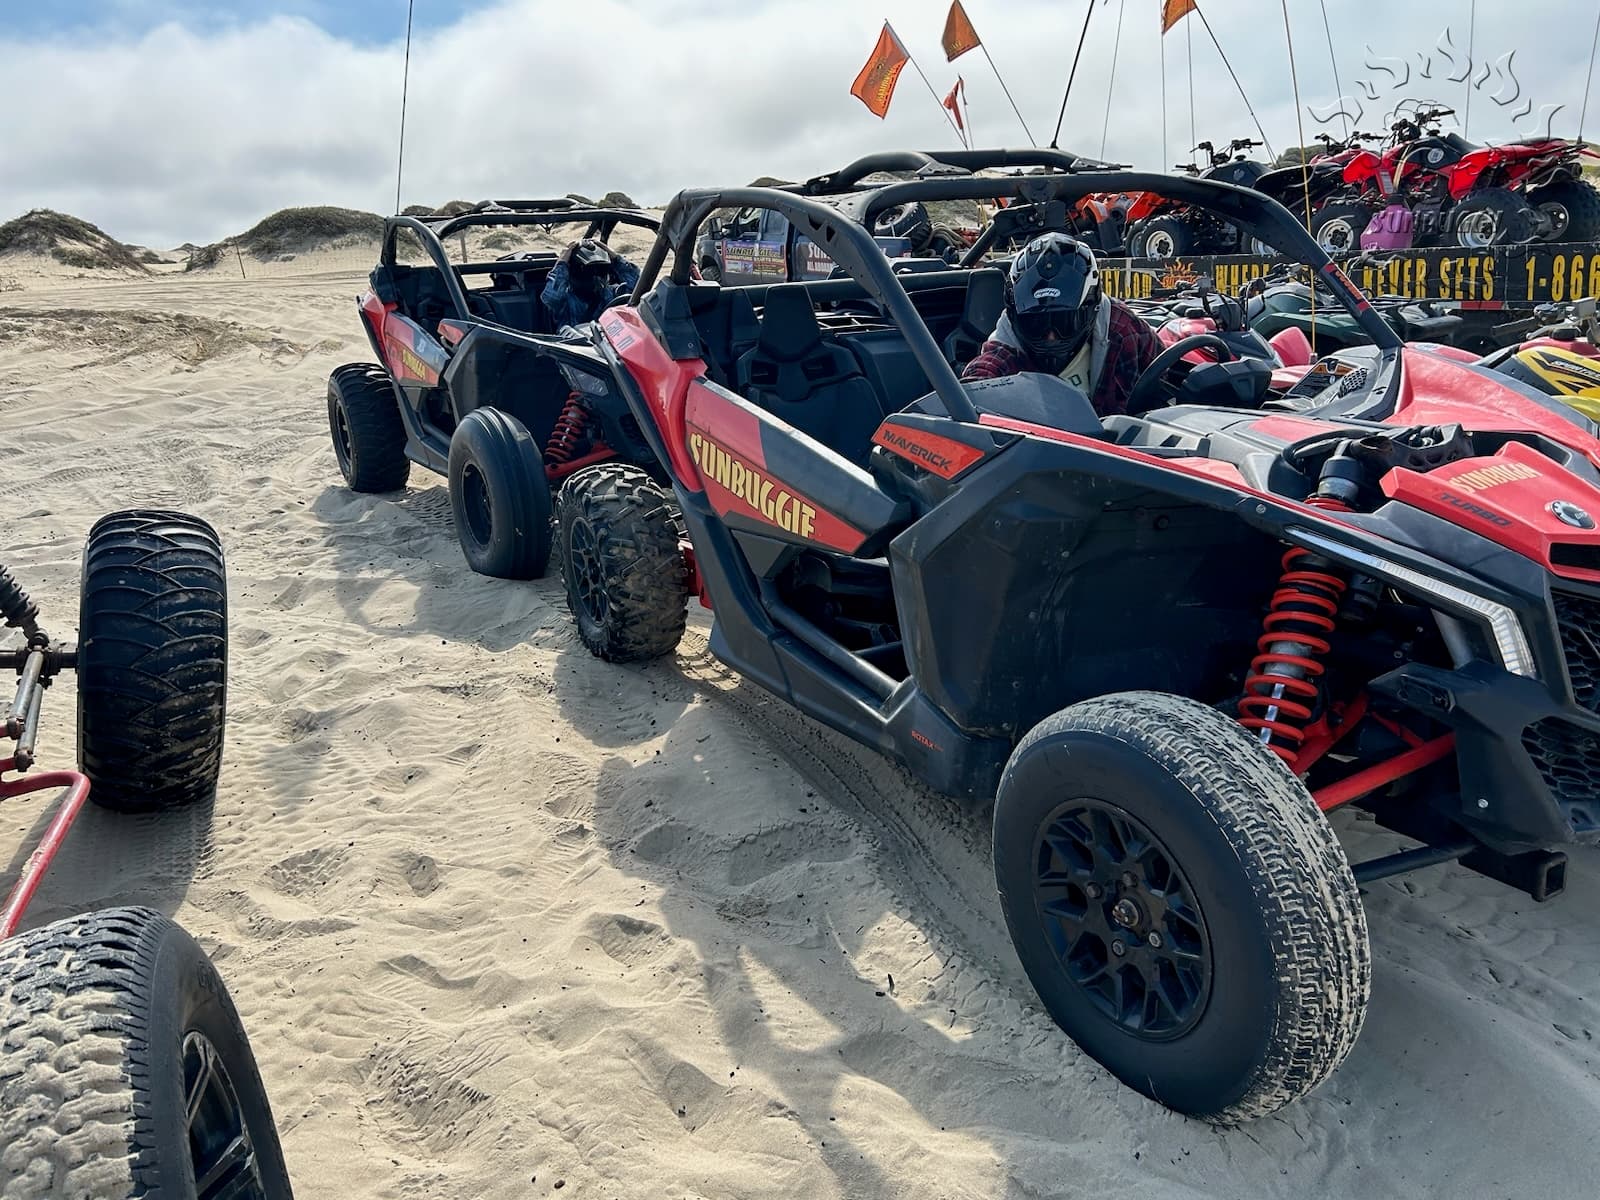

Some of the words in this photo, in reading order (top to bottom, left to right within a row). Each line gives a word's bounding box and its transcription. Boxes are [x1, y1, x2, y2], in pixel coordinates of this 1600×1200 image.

[1439, 254, 1495, 301] SETS
[1525, 254, 1600, 302] 1-866
[883, 429, 953, 471] MAVERICK
[1441, 492, 1512, 527] TURBO
